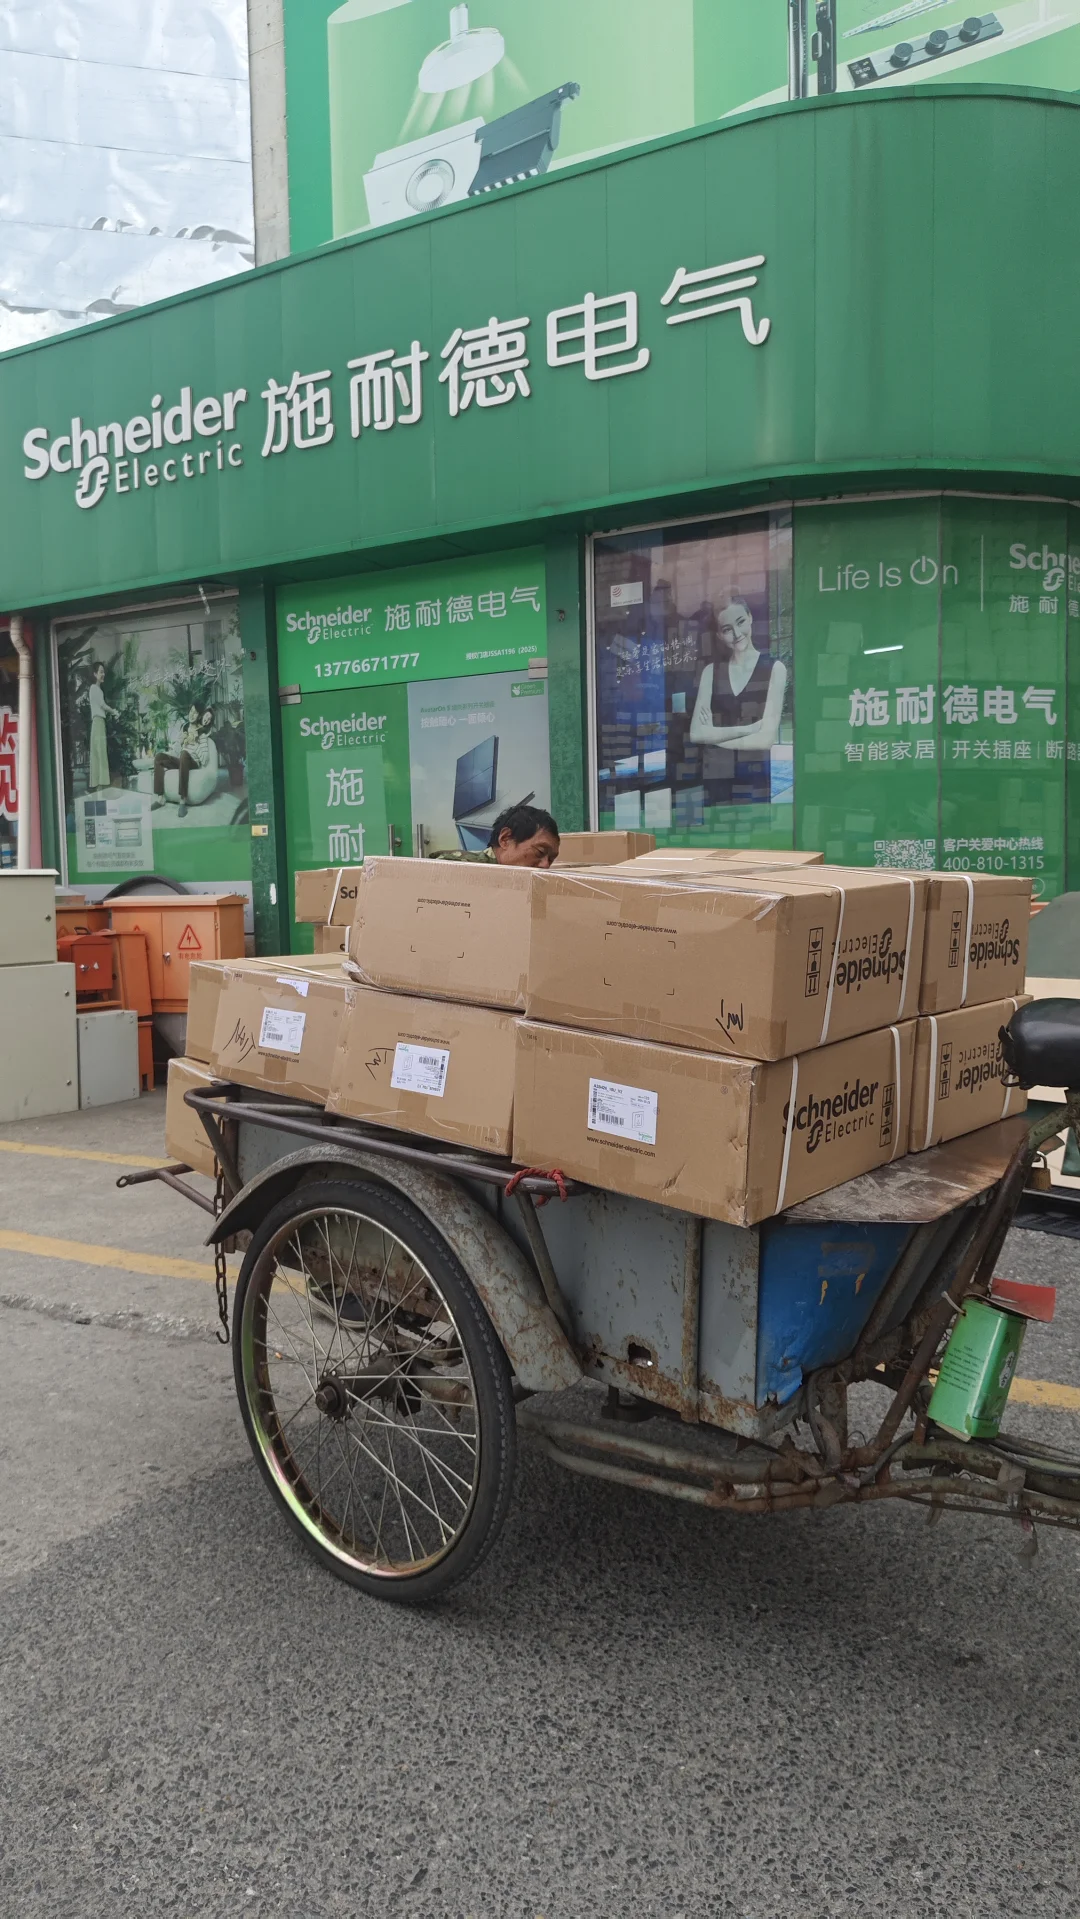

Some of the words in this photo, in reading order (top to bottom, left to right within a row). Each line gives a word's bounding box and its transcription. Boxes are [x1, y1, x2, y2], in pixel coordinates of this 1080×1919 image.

[260, 254, 771, 458] 施耐德电气
[23, 386, 247, 480] Schneider
[114, 441, 243, 493] Electric
[818, 566, 870, 593] Life
[878, 561, 902, 588] Is
[910, 555, 959, 586] On
[286, 605, 372, 633] Schneider
[384, 586, 541, 632] 施耐德电气
[322, 624, 371, 641] Electric
[314, 652, 420, 678] 13776671777
[848, 684, 1058, 728] 施耐德电气
[299, 712, 388, 741] Schneider
[336, 733, 386, 747] Electric
[844, 738, 936, 763] 智能家居
[952, 739, 1032, 760] 开关插座
[1046, 739, 1080, 761] 断路
[943, 837, 1044, 852] 客户关爱中心热线
[943, 857, 1044, 871] 400-810-1315
[606, 920, 677, 934] www.schneider-electric.com
[972, 922, 1001, 939] Electri
[964, 939, 1020, 970] Schneide
[397, 1032, 450, 1045] www.schneider-electric.com
[958, 1042, 995, 1066] Electric
[955, 1060, 1006, 1093] hneider
[782, 1078, 879, 1136] Schneider
[824, 1111, 875, 1143] Electric
[586, 1136, 656, 1157] www.schneider-electric.com
